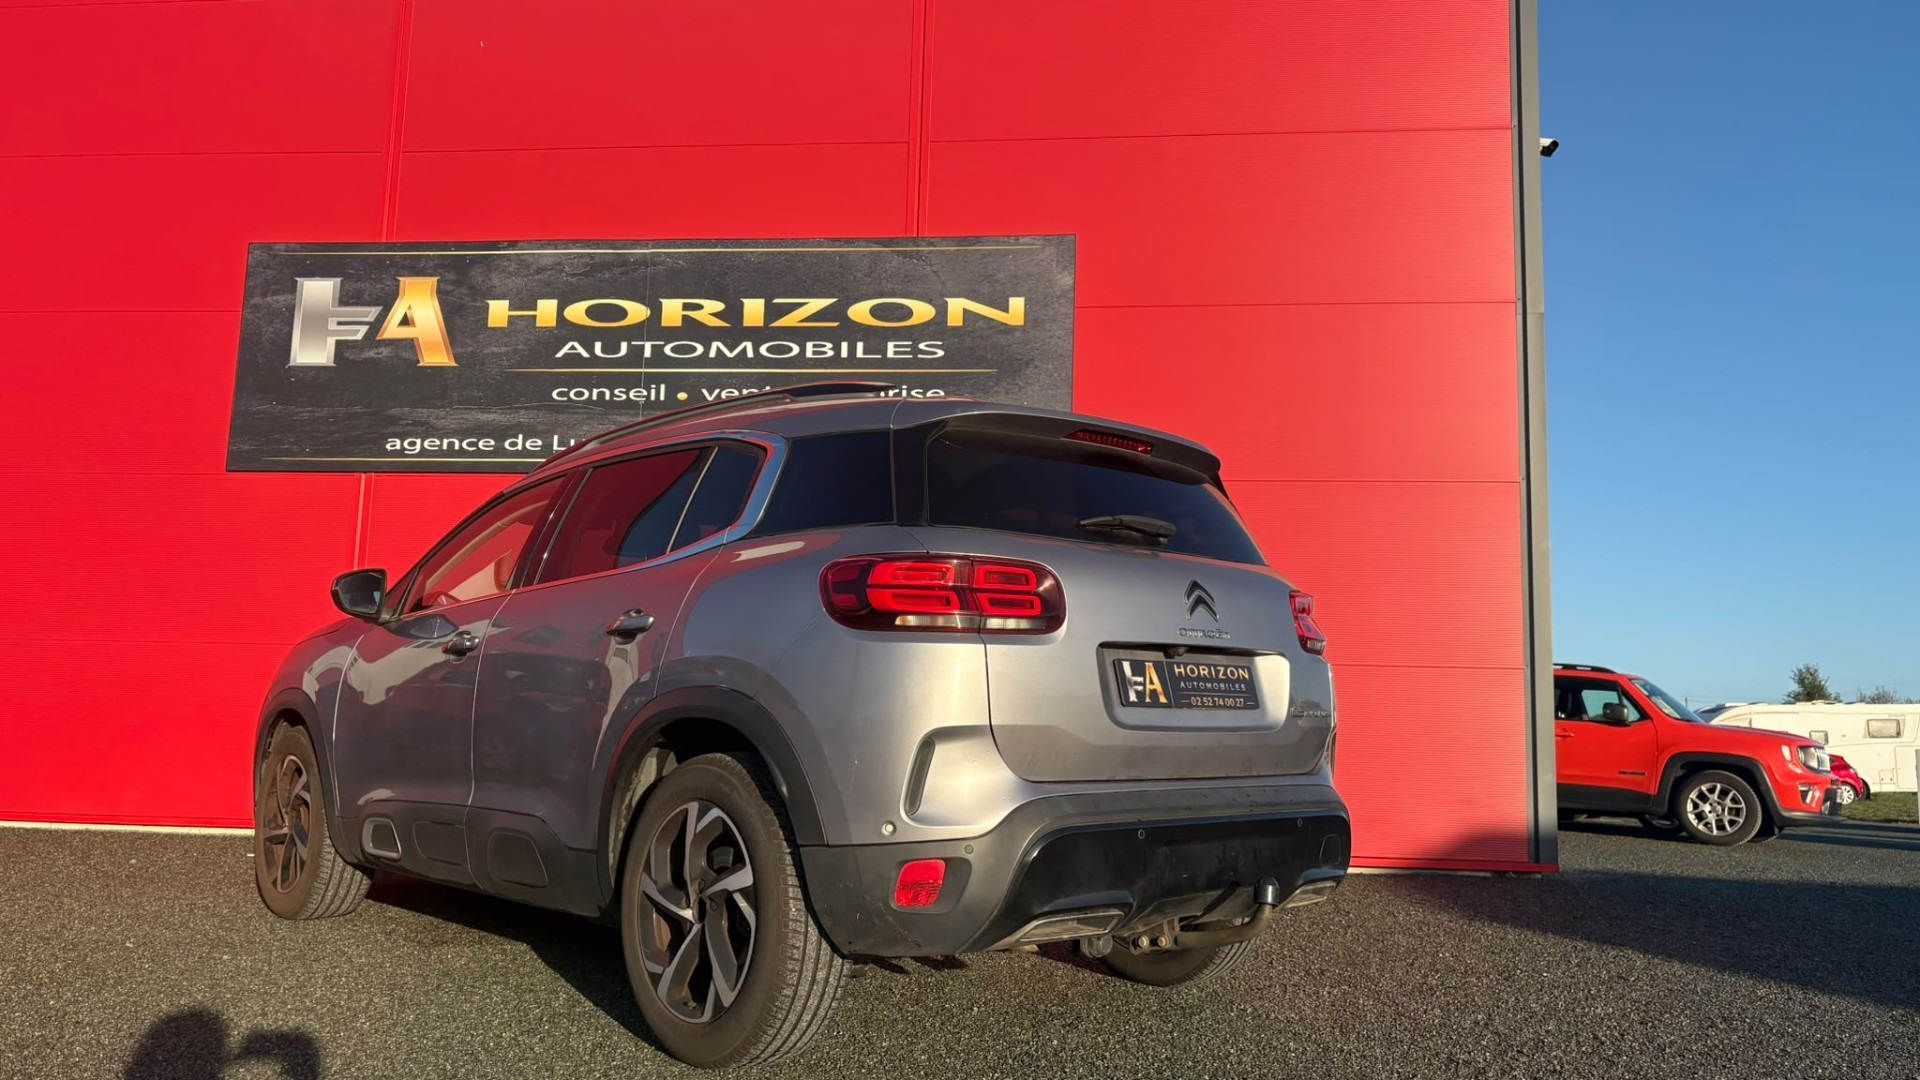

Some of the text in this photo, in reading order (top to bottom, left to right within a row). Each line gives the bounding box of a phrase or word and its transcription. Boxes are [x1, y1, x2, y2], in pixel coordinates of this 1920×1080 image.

[486, 297, 1025, 328] HORIZON
[555, 340, 945, 359] AUTOMOBILES
[551, 383, 666, 401] conseil
[385, 437, 496, 454] agence
[504, 434, 543, 451] de
[1173, 664, 1249, 680] HORIZON
[1180, 681, 1246, 691] AUTOMOBILES
